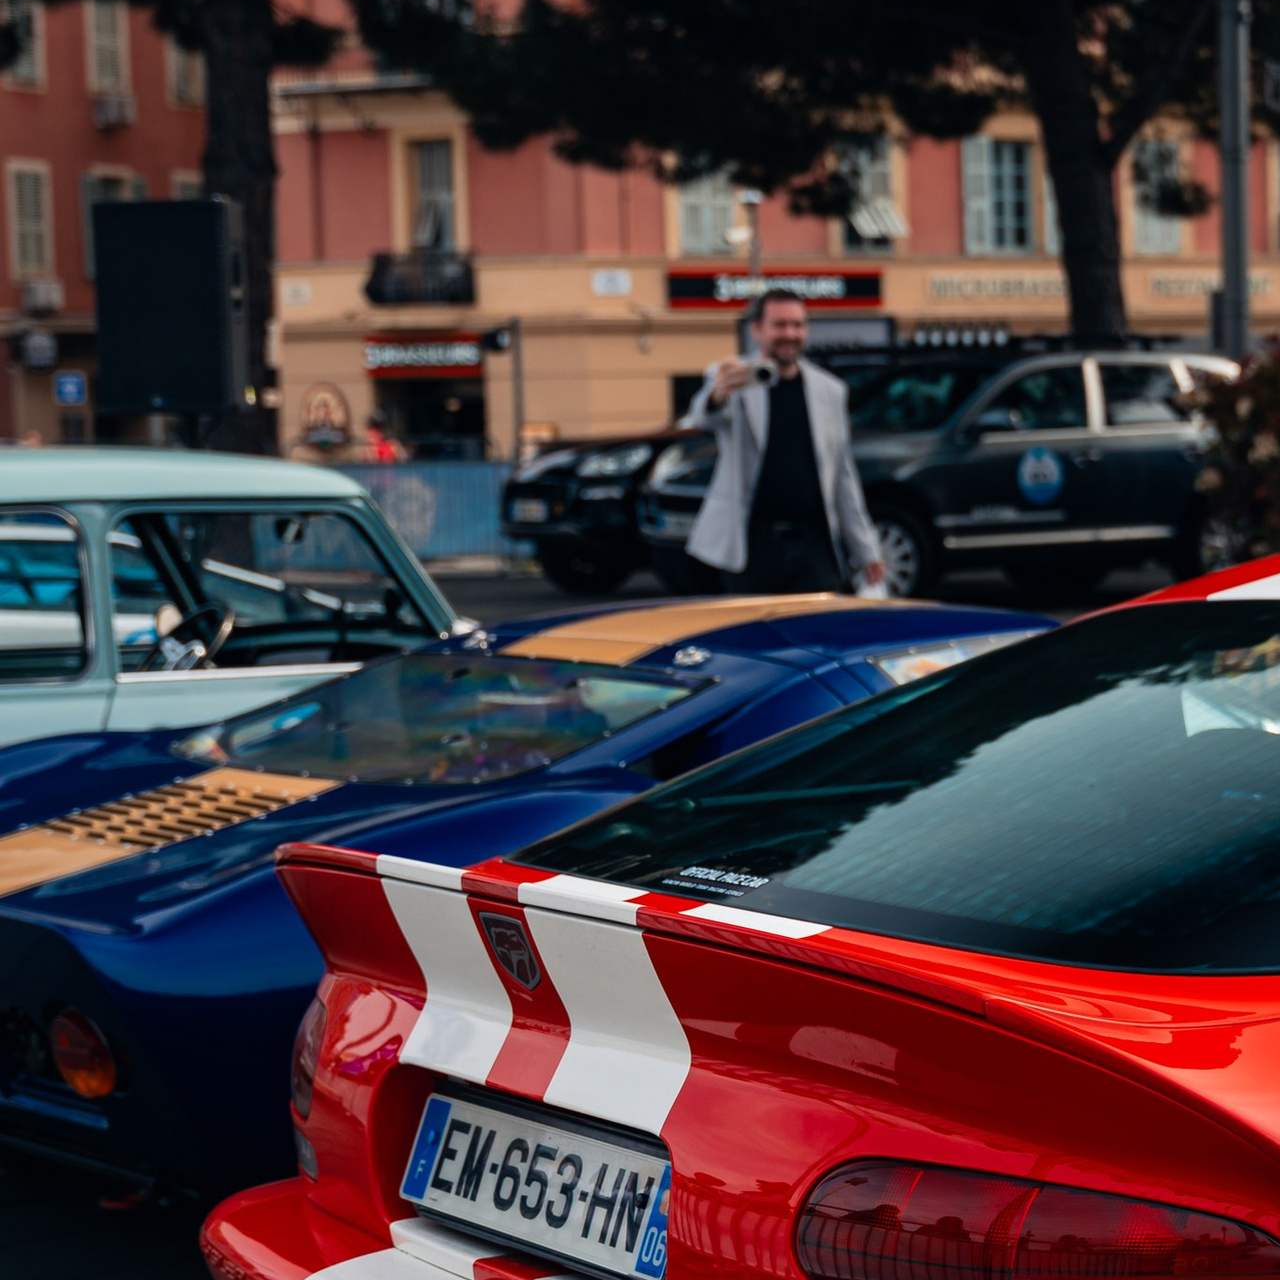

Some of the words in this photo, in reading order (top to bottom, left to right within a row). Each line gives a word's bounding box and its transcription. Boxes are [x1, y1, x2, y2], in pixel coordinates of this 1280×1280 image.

[414, 1159, 427, 1181] F
[430, 1118, 656, 1254] EM-653-HN
[641, 1226, 667, 1267] 06
